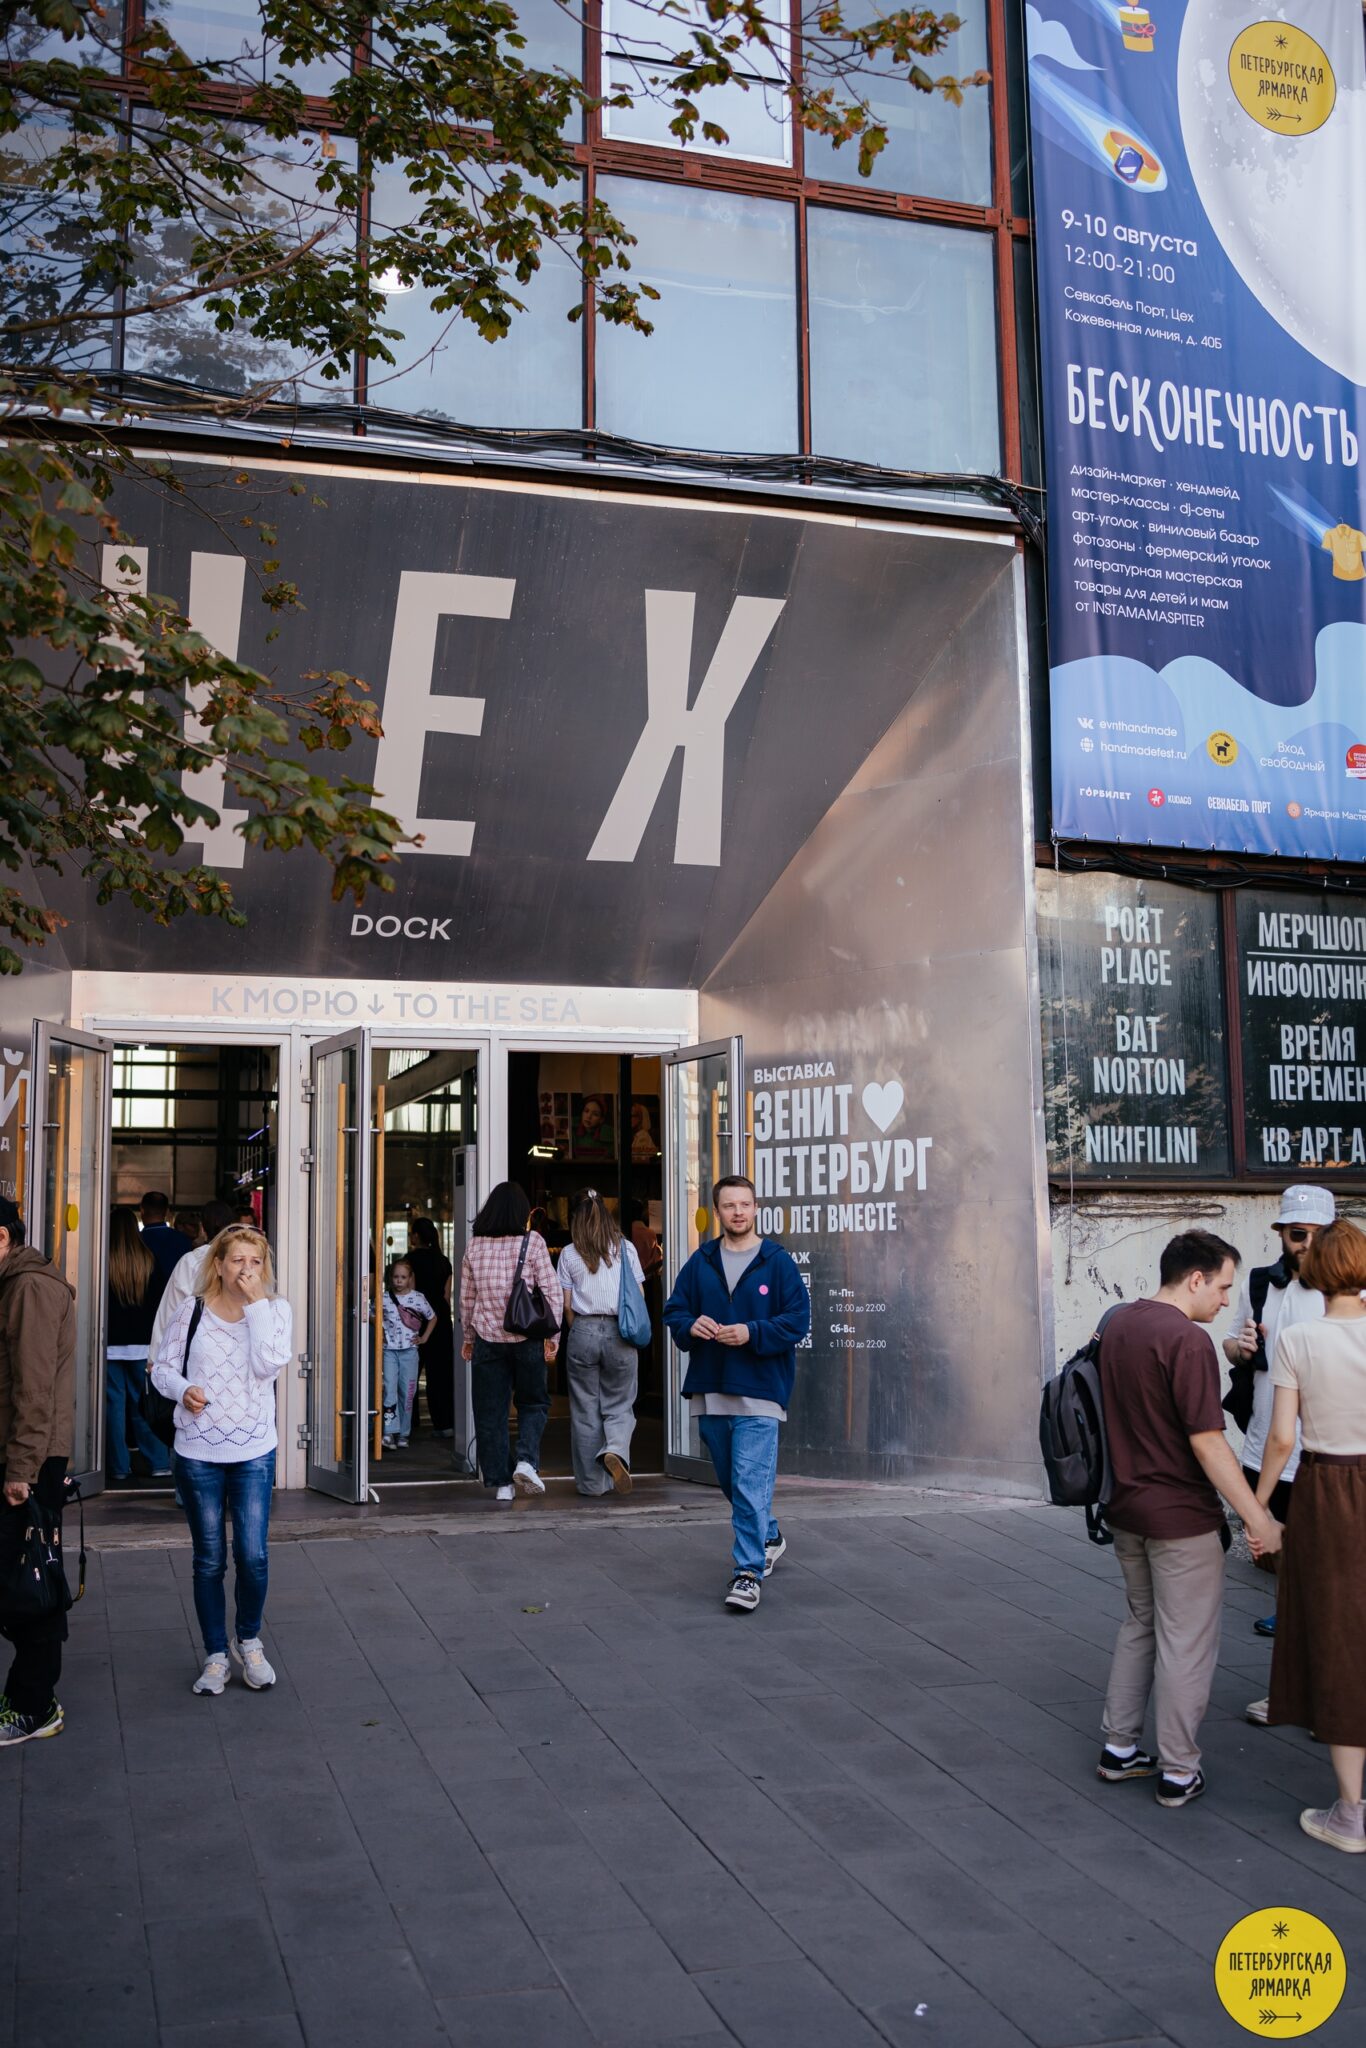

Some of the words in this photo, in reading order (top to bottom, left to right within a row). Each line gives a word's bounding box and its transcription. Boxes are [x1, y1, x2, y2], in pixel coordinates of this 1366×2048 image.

[1240, 53, 1324, 86] ПЕТЕРБУРГСКАЯ
[1257, 79, 1308, 104] ЯРМАРКА
[1061, 209, 1107, 237] 9-10
[1113, 225, 1198, 257] августа
[1064, 244, 1175, 284] 12:00-21:00
[1064, 286, 1133, 311] Севкабель
[1136, 301, 1168, 320] Порт,
[1171, 309, 1194, 323] Цех
[1065, 309, 1142, 335] Кожевенная
[1145, 325, 1183, 344] линия,
[1186, 334, 1197, 346] д.
[1200, 335, 1222, 350] 40Б
[1067, 364, 1359, 467] БЕСКОНЕЧНОСТЬ
[1070, 464, 1166, 489] дизайн-маркет
[1176, 481, 1240, 500] хендмейд
[1071, 487, 1170, 511] мастер-классы
[1180, 503, 1225, 519] dj-сеты
[1072, 510, 1139, 530] арт-уголок
[1148, 522, 1217, 540] виниловый
[1219, 529, 1260, 547] базар
[1073, 532, 1136, 552] фотозоны
[1145, 543, 1229, 565] фермерский
[1231, 555, 1271, 570] уголок
[1074, 557, 1162, 579] литературная
[1165, 570, 1243, 589] мастерская
[1074, 580, 1121, 597] товары
[1124, 587, 1147, 600] для
[1150, 591, 1187, 605] детей
[1190, 597, 1198, 606] и
[1201, 598, 1229, 610] мам
[1075, 602, 1090, 612] от
[1093, 602, 1205, 628] INSTAMAMASPITER
[1099, 720, 1178, 737] evnthandmade
[1100, 741, 1187, 760] handmadefest.ru
[1259, 757, 1325, 772] свободный
[1278, 742, 1305, 756] Вход
[1207, 796, 1250, 813] СЕВКАБЕЛЬ
[1251, 800, 1271, 814] ПОРТ
[1303, 807, 1340, 820] Ярмарка
[351, 914, 453, 940] DOCK
[1105, 905, 1164, 944] PORT
[1259, 912, 1366, 952] МЕРЧШОП
[1101, 946, 1172, 986] PLACE
[212, 986, 233, 1013] К
[243, 987, 358, 1015] МОРЮ
[393, 992, 438, 1018] TO
[446, 993, 511, 1022] THE
[519, 996, 582, 1023] SEA
[1116, 1015, 1160, 1052] BAT
[1281, 1024, 1356, 1062] ВРЕМЯ
[754, 1061, 836, 1084] ВЫСТАВКА
[1093, 1057, 1186, 1095] NORTON
[1270, 1065, 1366, 1102] ПЕРЕМЕН
[754, 1084, 853, 1142] ЗЕНИТ
[1085, 1125, 1198, 1164] NIKIFILINI
[755, 1137, 932, 1198] ПЕТЕРБУРГ
[756, 1206, 784, 1235] 100
[789, 1205, 821, 1234] ЛЕТ
[827, 1202, 897, 1233] ВМЕСТЕ
[836, 1304, 855, 1312] 12:00
[865, 1303, 886, 1312] 22:00
[836, 1340, 855, 1348] 11:00
[856, 1341, 865, 1349] до
[866, 1340, 887, 1349] 22:00
